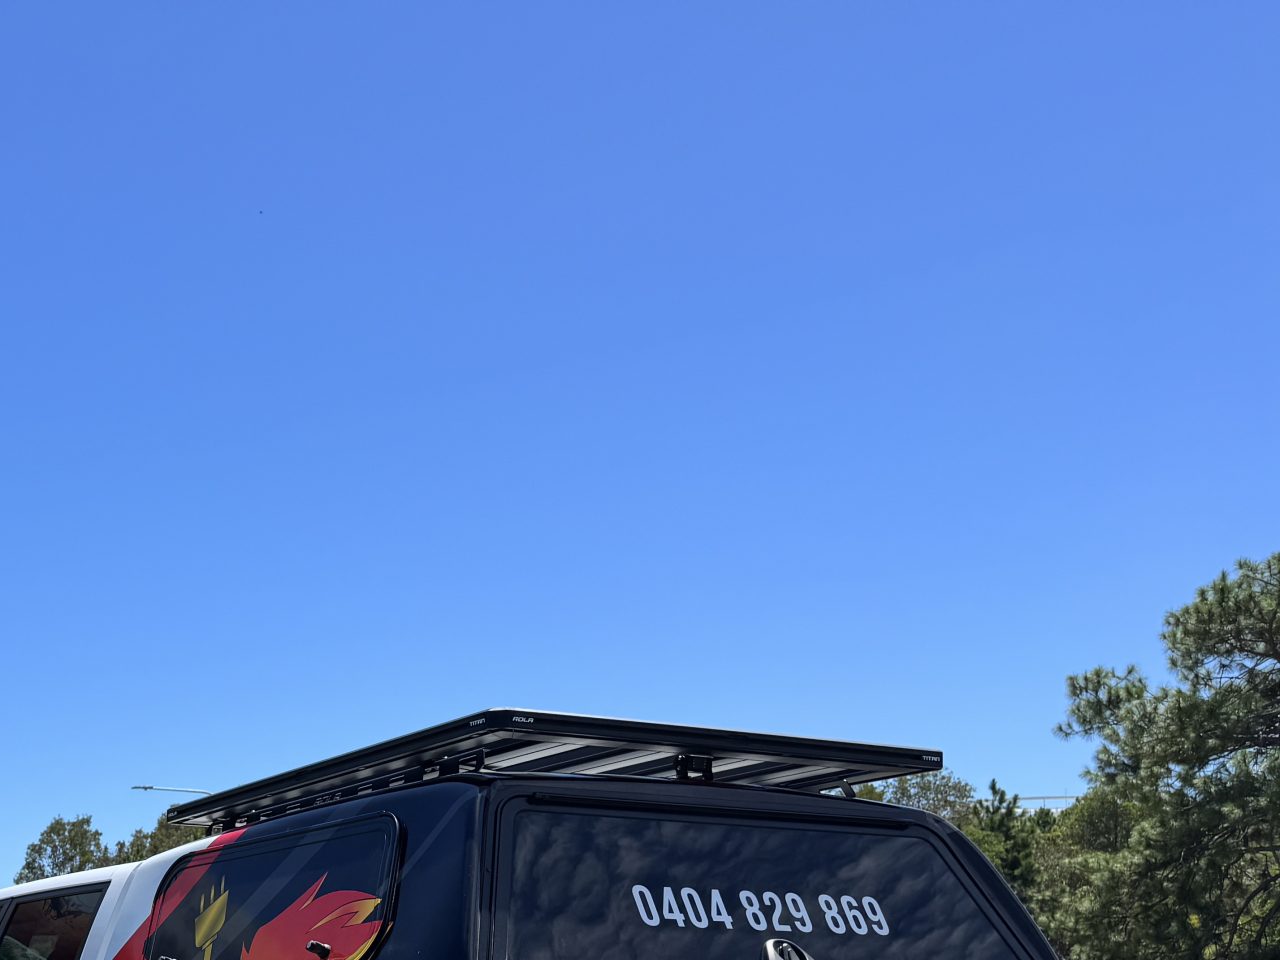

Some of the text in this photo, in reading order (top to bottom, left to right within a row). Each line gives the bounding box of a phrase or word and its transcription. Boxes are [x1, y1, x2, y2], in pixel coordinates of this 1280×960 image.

[469, 718, 486, 727] TITAN
[512, 716, 534, 724] ROLA
[631, 884, 890, 936] 0404 829 869
